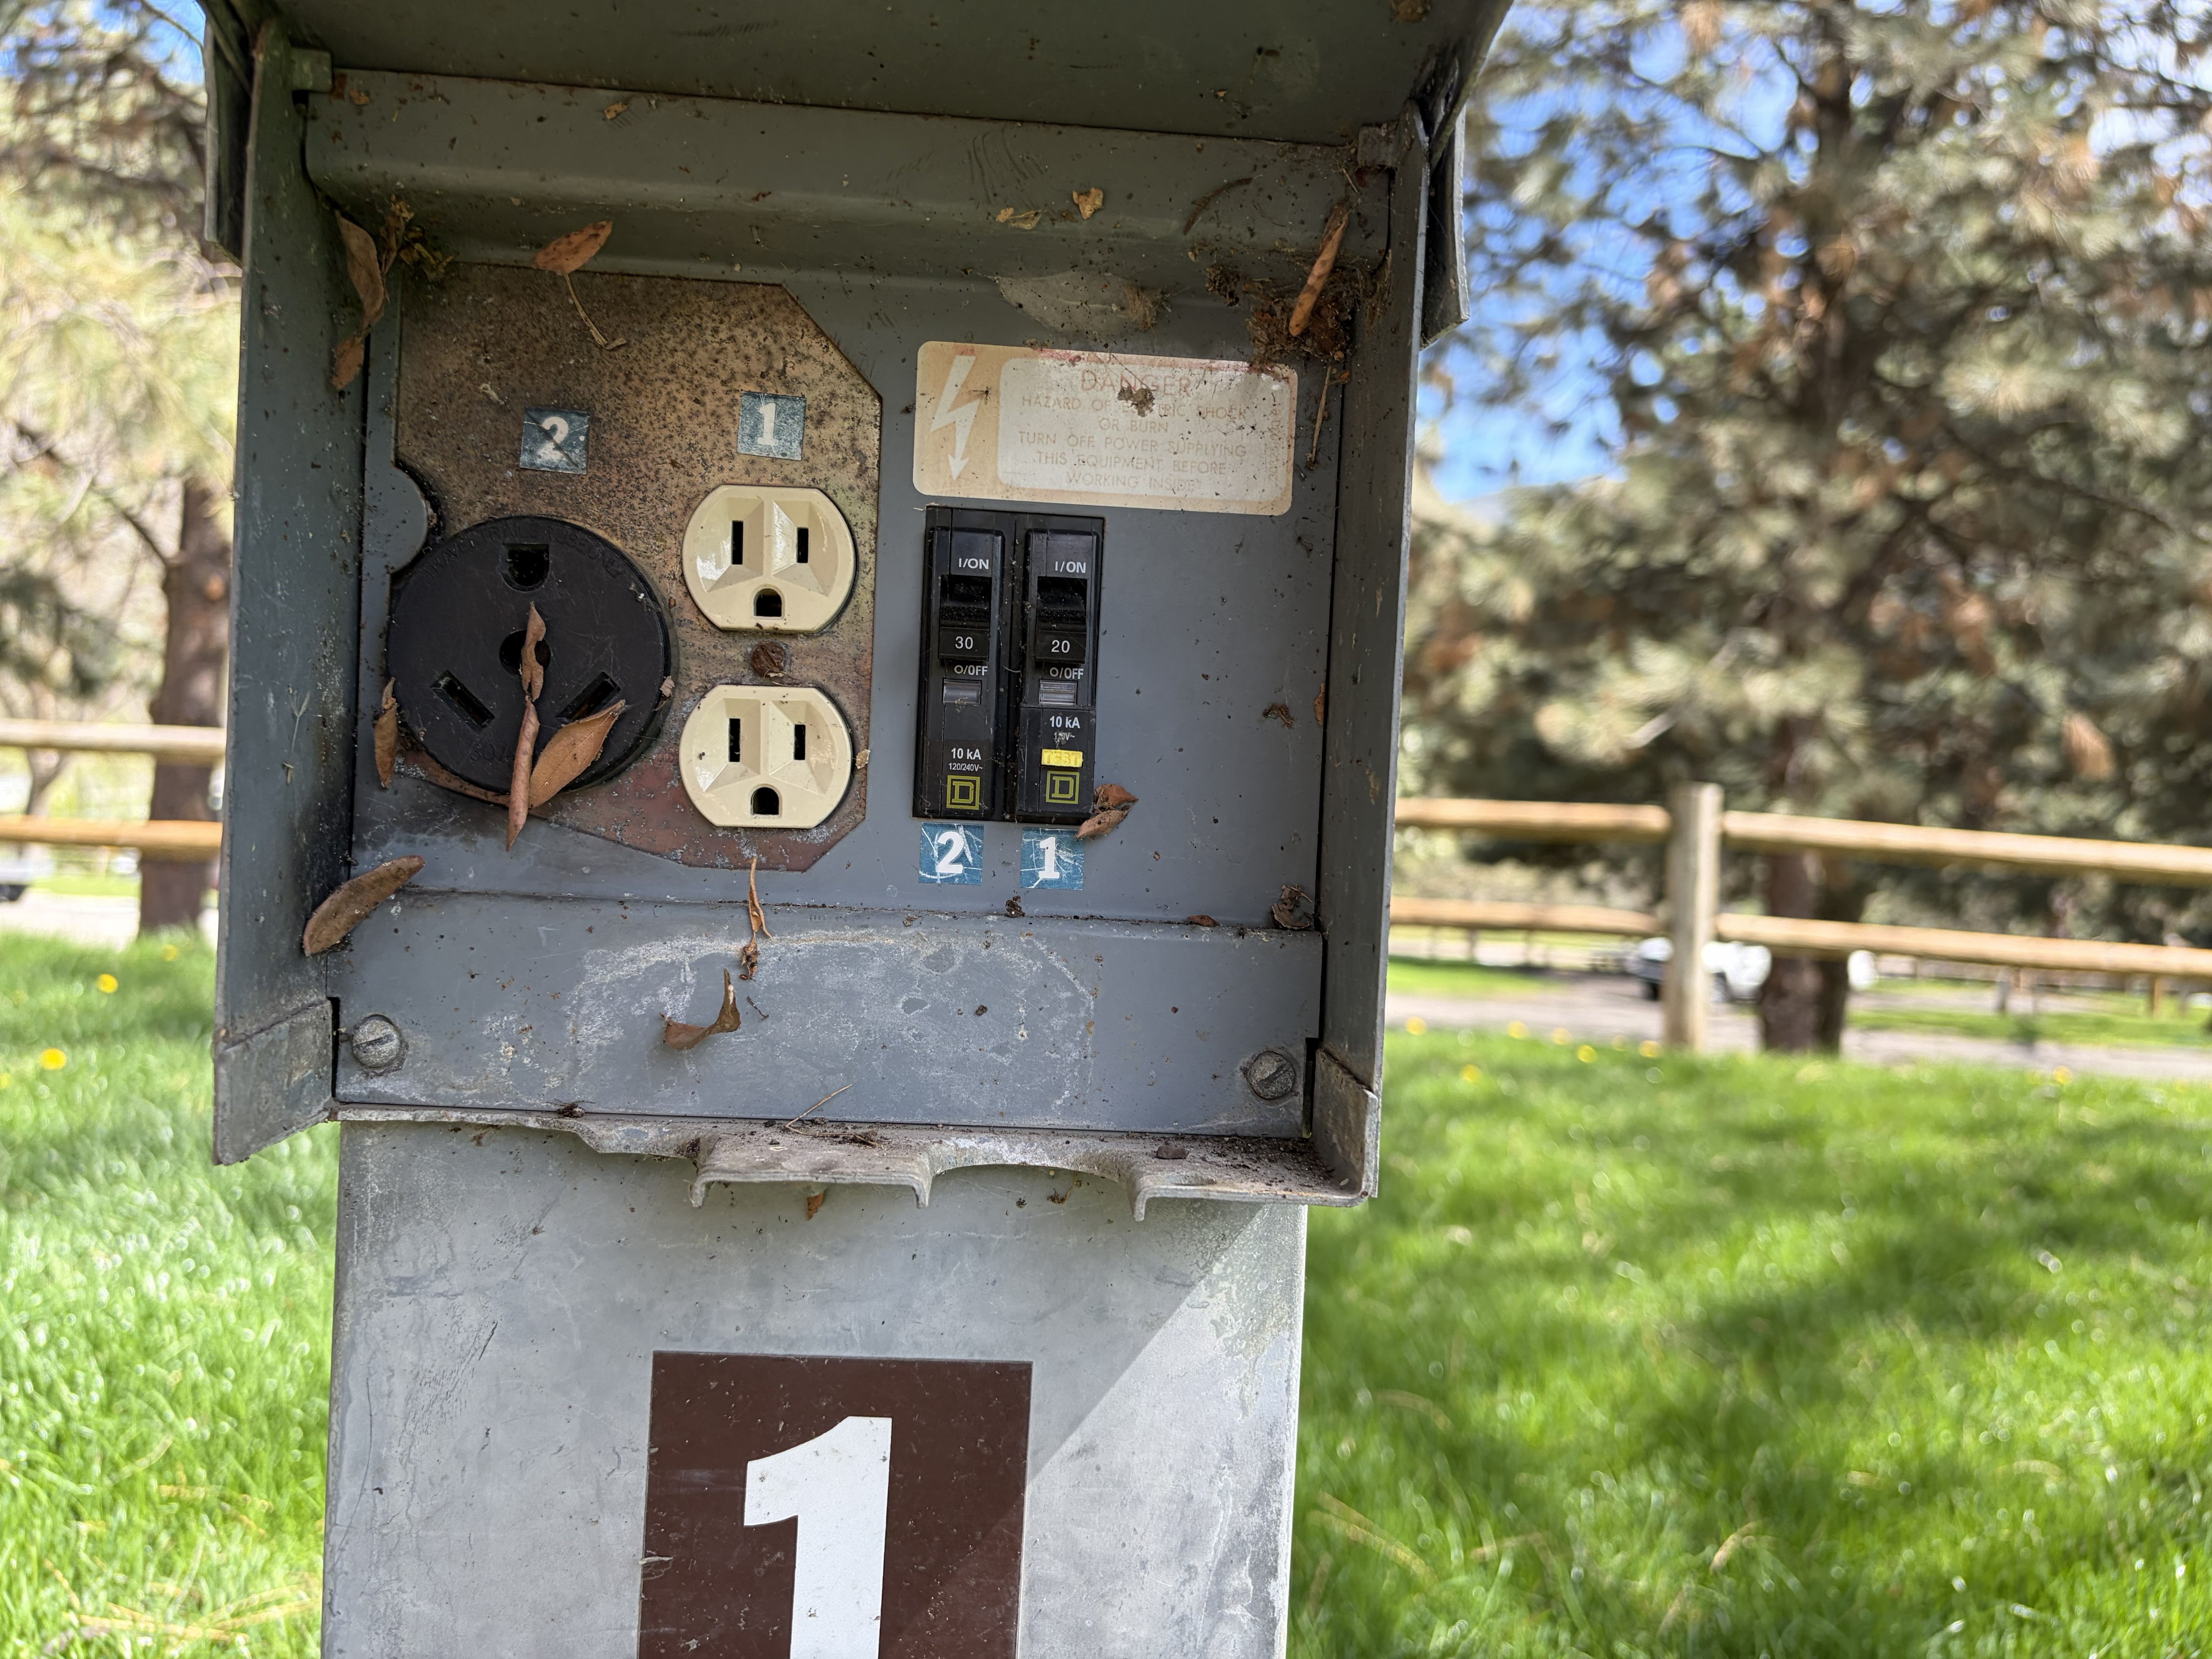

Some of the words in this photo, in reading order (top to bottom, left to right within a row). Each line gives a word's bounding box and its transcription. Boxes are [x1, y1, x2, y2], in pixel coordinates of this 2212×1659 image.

[1082, 369, 1191, 397] DANGER
[1022, 396, 1082, 410] HAZARD
[1092, 399, 1111, 412] OF
[757, 402, 779, 447] 1
[1099, 418, 1119, 431] OR
[1130, 420, 1168, 433] BURN
[536, 416, 569, 462] 2
[1018, 431, 1056, 445] TURN
[1066, 434, 1095, 448] OFF
[1104, 436, 1158, 452] POWER
[1167, 441, 1247, 458] SUPPLYING
[1036, 452, 1068, 466] THIS
[1077, 454, 1163, 470] EQUIPMENT
[1173, 461, 1226, 475] BEFORE
[1067, 472, 1139, 489] WORKING
[1149, 477, 1197, 492] INSIDE
[955, 636, 974, 650] 30
[1051, 640, 1070, 653] 20
[1049, 716, 1062, 728] 10
[1065, 716, 1080, 729] kA
[951, 747, 963, 759] 10
[967, 749, 981, 760] kA
[1044, 750, 1080, 766] TEST
[936, 831, 965, 874] 2
[1039, 836, 1060, 879] 1
[744, 1415, 892, 1659] 1
